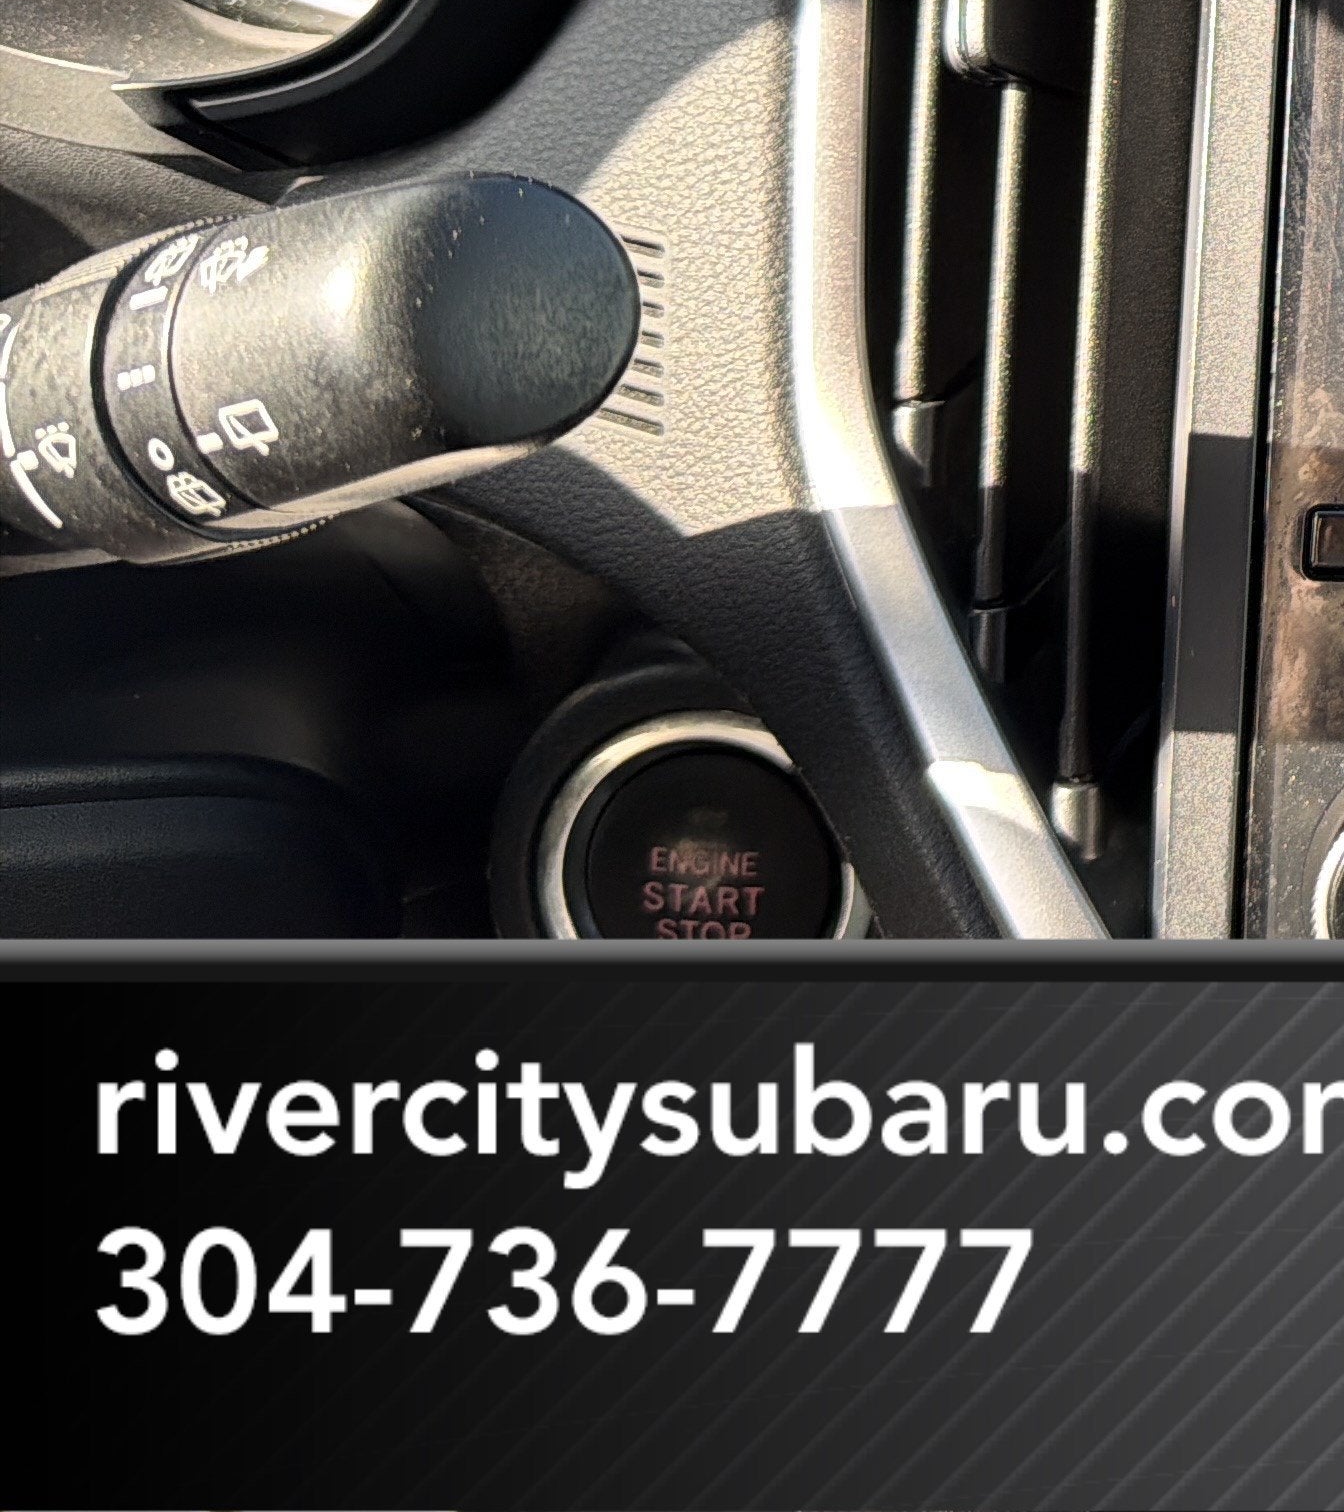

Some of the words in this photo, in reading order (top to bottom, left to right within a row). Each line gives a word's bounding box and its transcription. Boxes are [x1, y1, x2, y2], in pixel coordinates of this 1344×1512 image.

[650, 845, 760, 877] ENGINE
[641, 881, 766, 916] START
[656, 919, 751, 938] STOP
